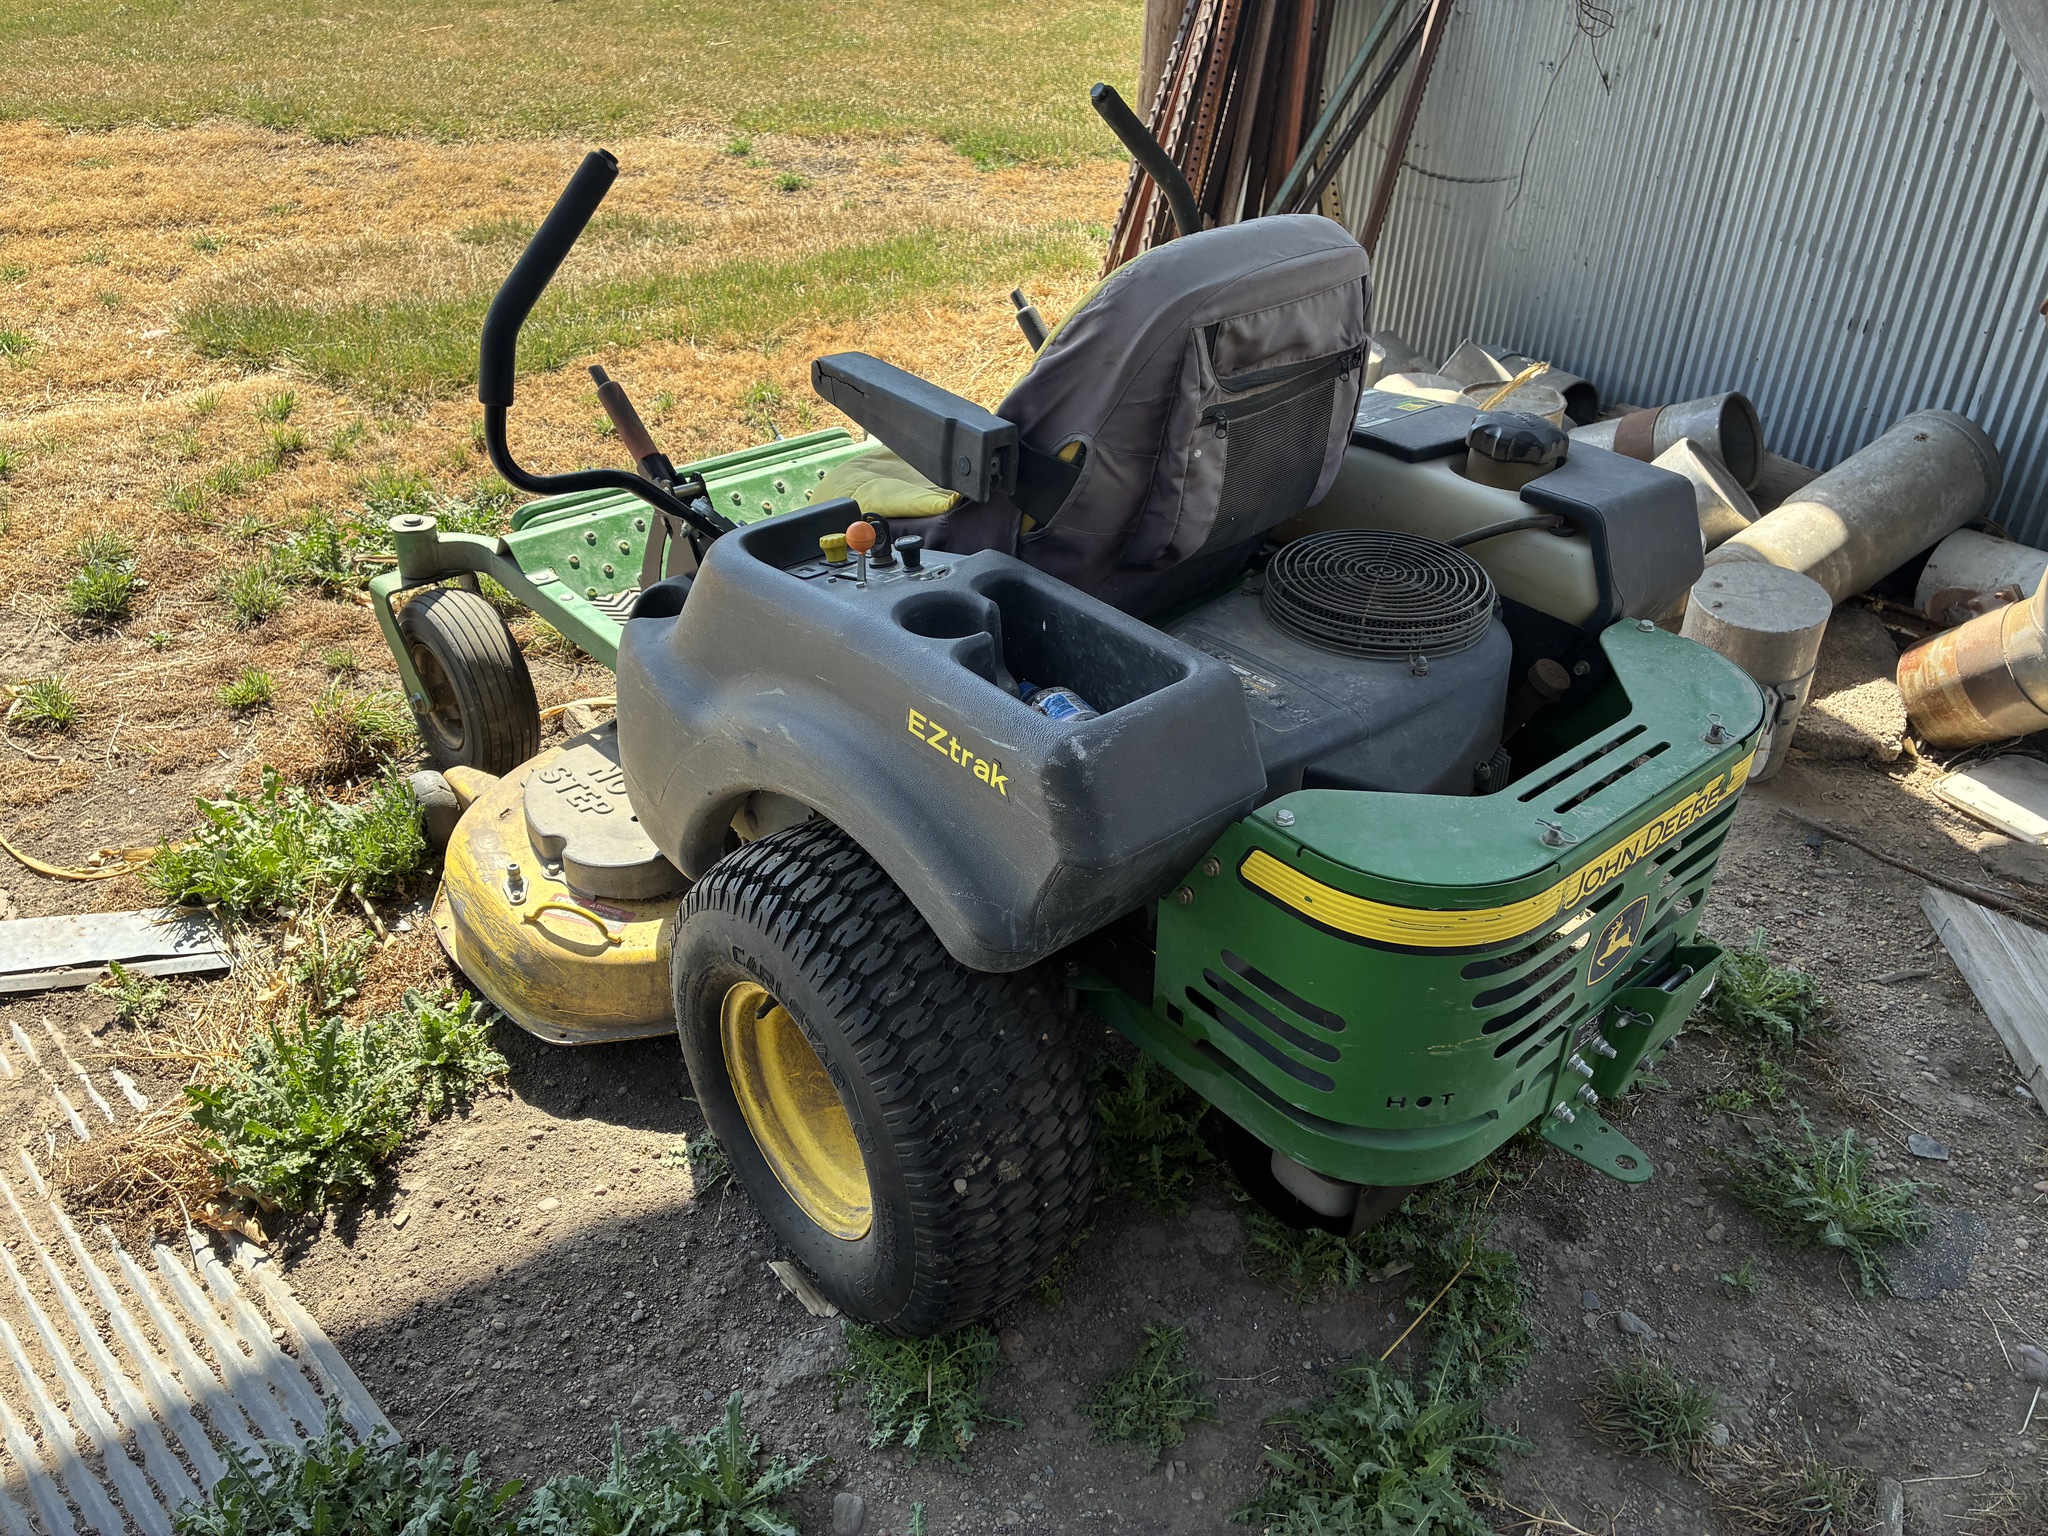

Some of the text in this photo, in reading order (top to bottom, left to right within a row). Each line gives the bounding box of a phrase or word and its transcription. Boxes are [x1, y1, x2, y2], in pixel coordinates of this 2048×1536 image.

[909, 708, 1008, 796] EZtrak
[539, 767, 615, 814] STEP
[1566, 788, 1721, 908] JOHN DEERE
[596, 904, 621, 914] DANGER
[1386, 1092, 1455, 1108] HOT
